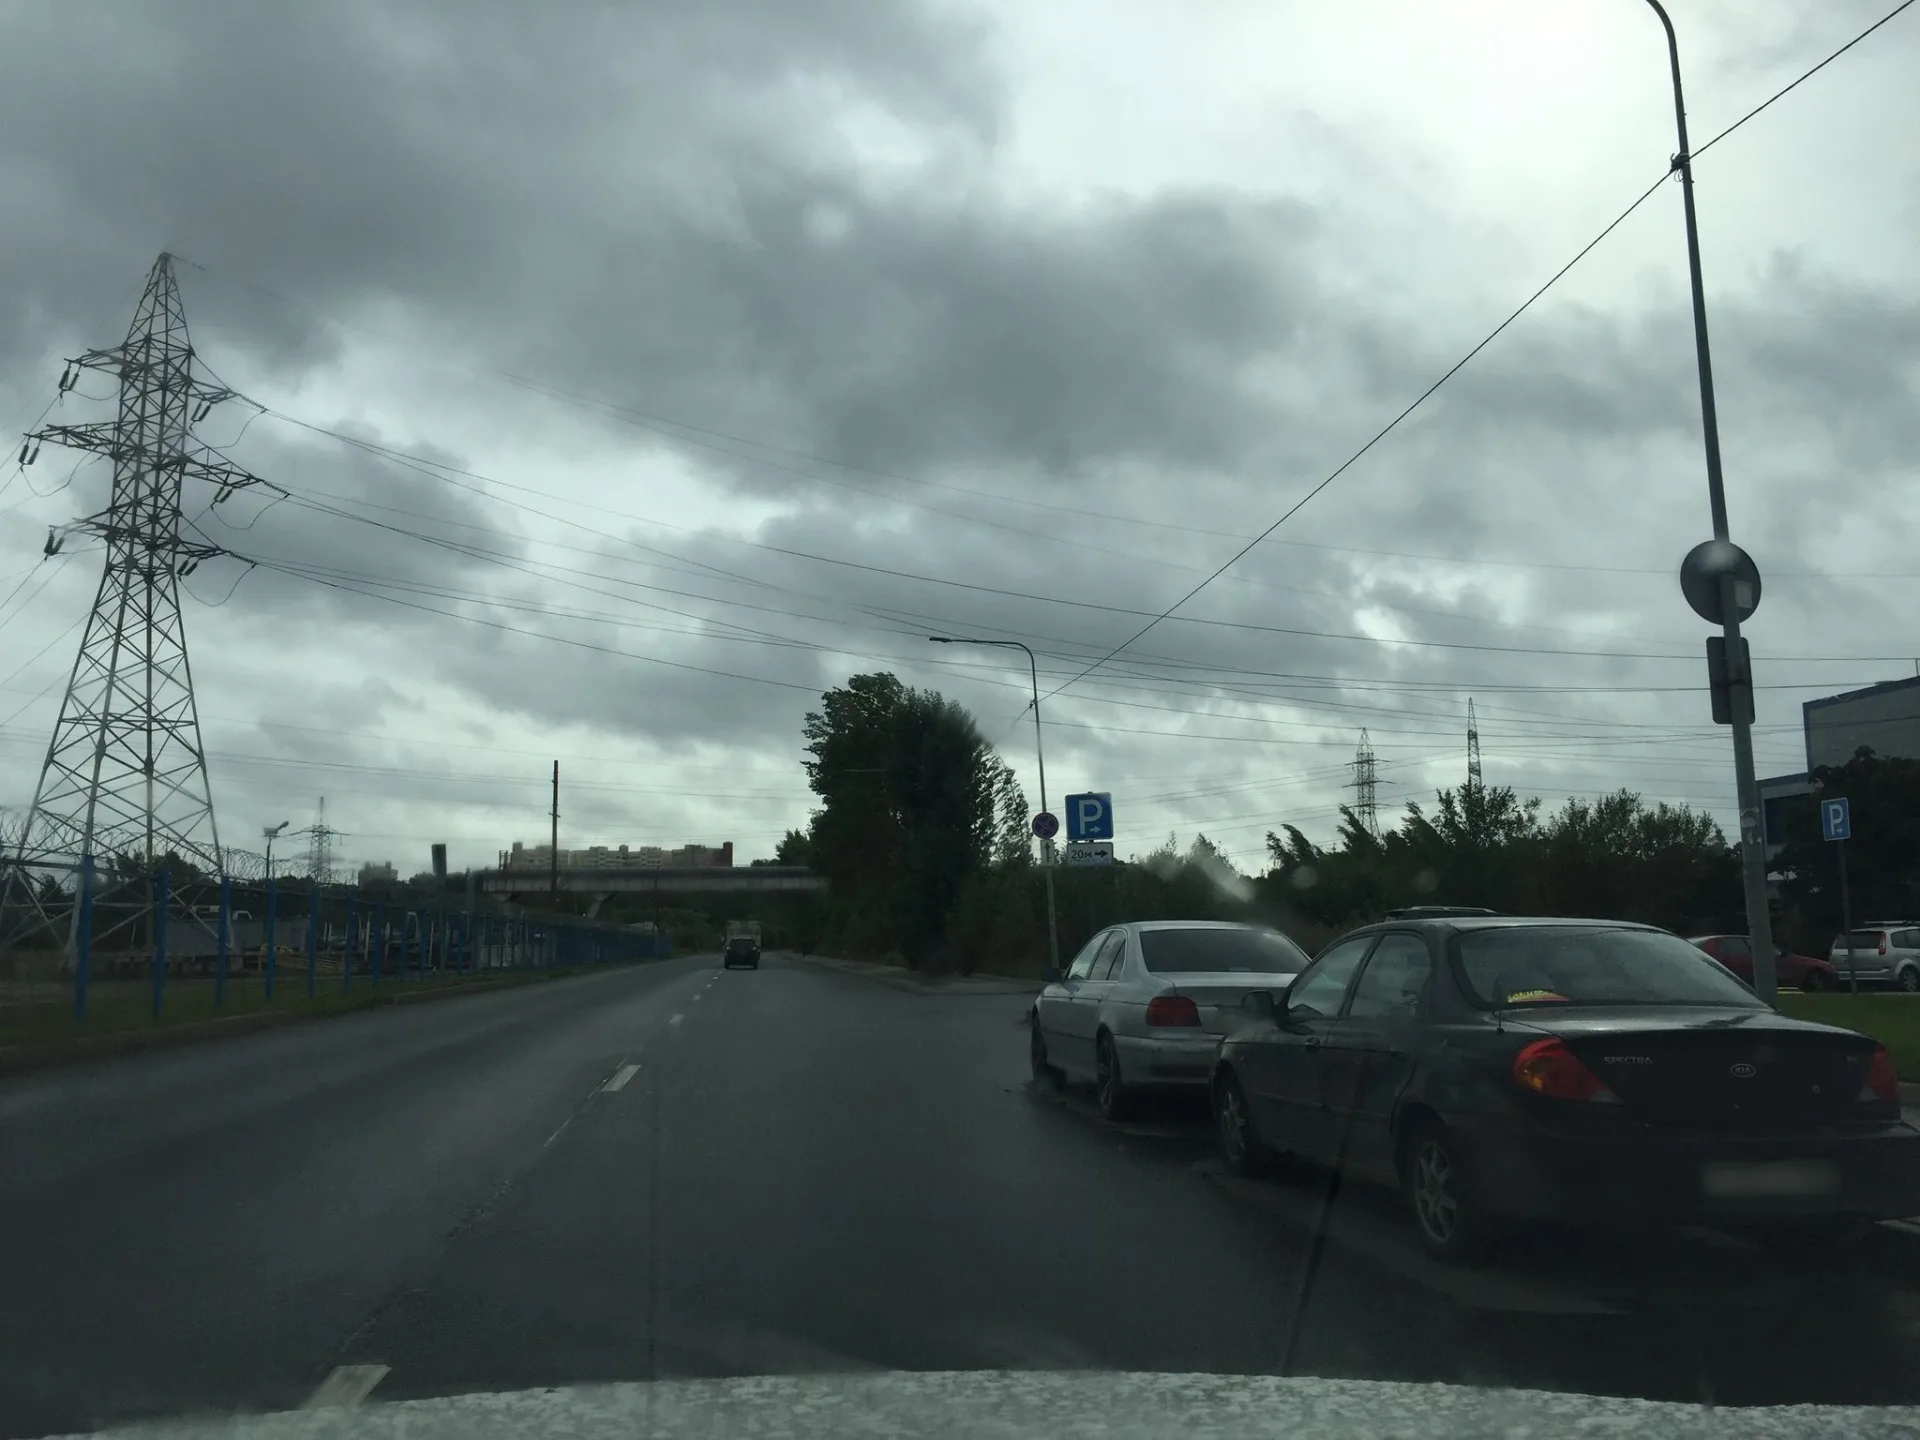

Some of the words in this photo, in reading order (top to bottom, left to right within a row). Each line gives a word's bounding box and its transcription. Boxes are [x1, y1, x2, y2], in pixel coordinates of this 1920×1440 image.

[1078, 799, 1103, 835] P
[1829, 804, 1844, 836] P
[1603, 1055, 1653, 1066] SPECTRA
